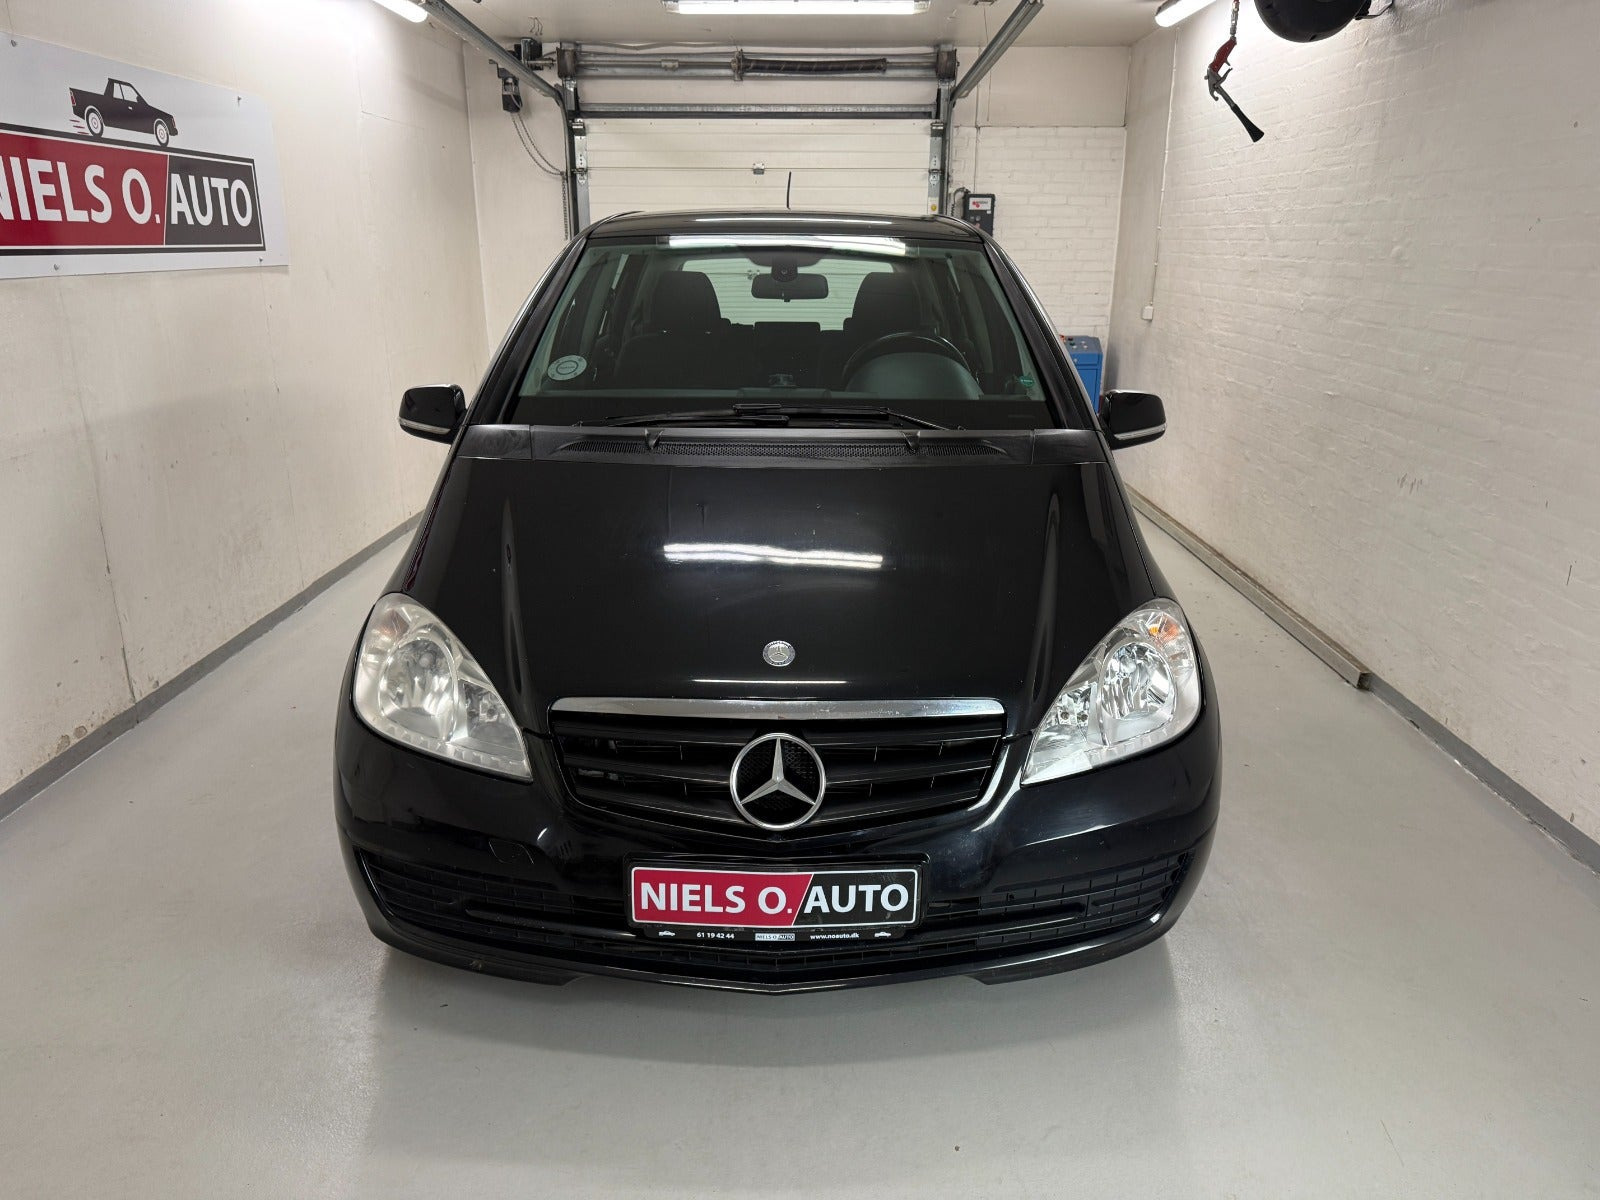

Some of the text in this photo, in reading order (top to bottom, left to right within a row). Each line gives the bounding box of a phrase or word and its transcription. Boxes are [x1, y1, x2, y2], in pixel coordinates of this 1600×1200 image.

[122, 168, 160, 225] O.
[171, 173, 252, 227] AUTO
[640, 882, 909, 915] NIELS O. AUTO
